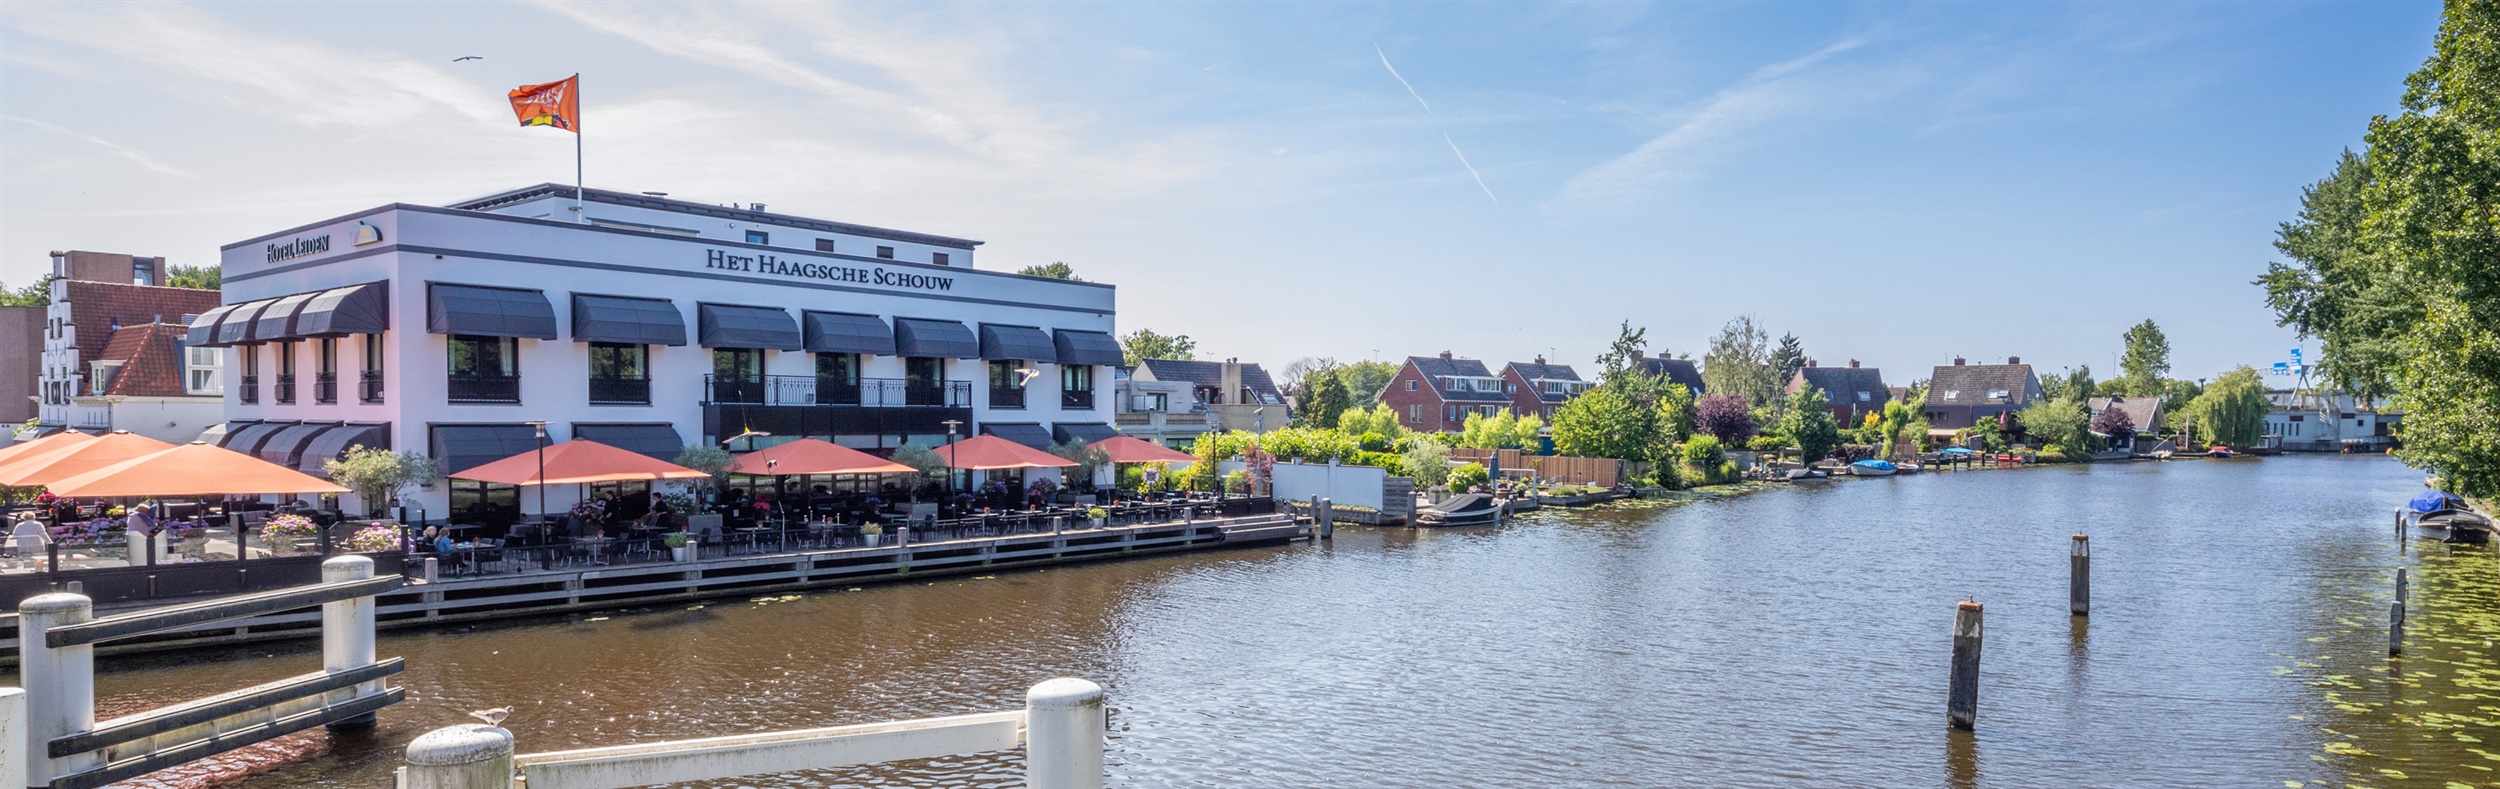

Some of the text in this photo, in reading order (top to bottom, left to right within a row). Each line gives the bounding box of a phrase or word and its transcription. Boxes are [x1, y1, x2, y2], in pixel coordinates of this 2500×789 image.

[266, 235, 330, 263] HOTEL LEIDEN
[705, 248, 954, 291] HET HAAGSCHE SCHOUW
